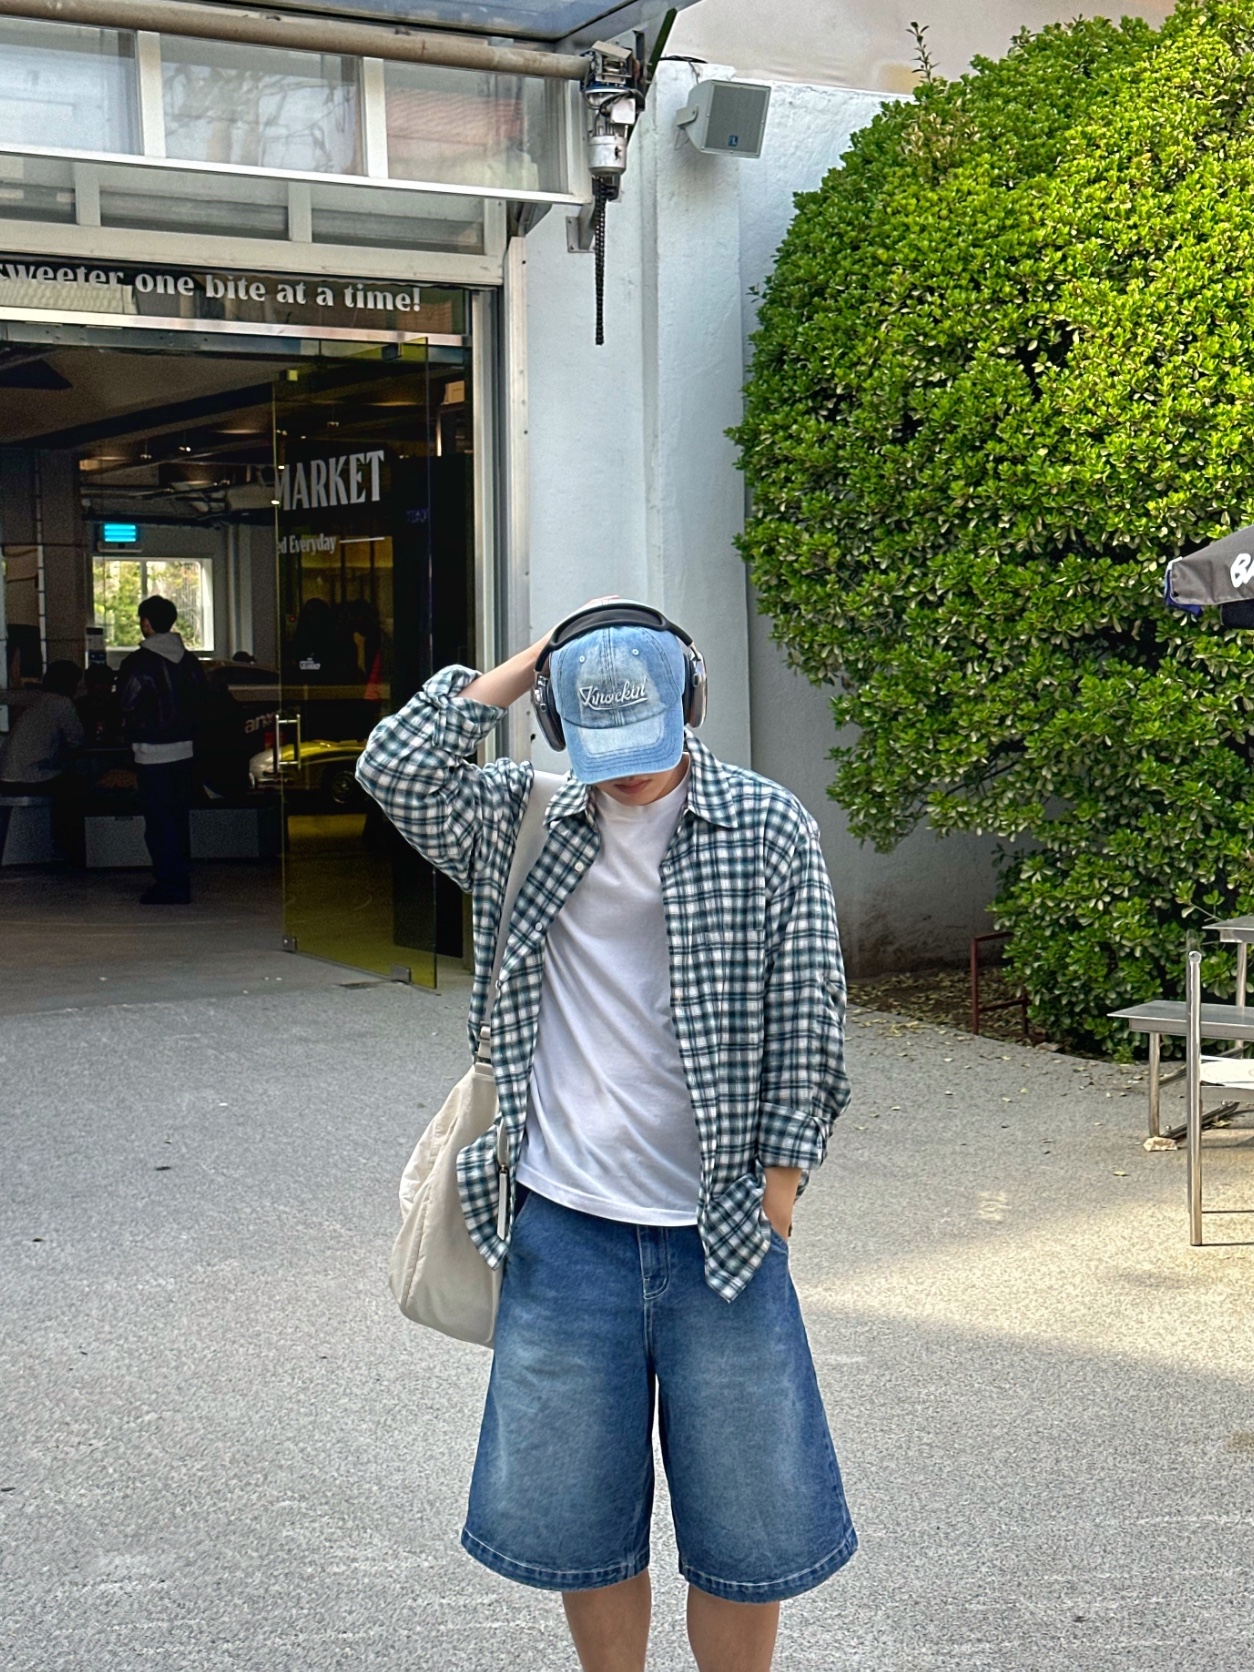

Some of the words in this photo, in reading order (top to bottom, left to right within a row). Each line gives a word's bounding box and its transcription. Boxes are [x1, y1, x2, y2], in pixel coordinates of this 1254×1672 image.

[135, 273, 195, 296] one
[205, 275, 266, 301] bite
[276, 282, 306, 304] at
[316, 286, 334, 306] a
[344, 283, 421, 312] time!
[289, 532, 337, 556] Everyday
